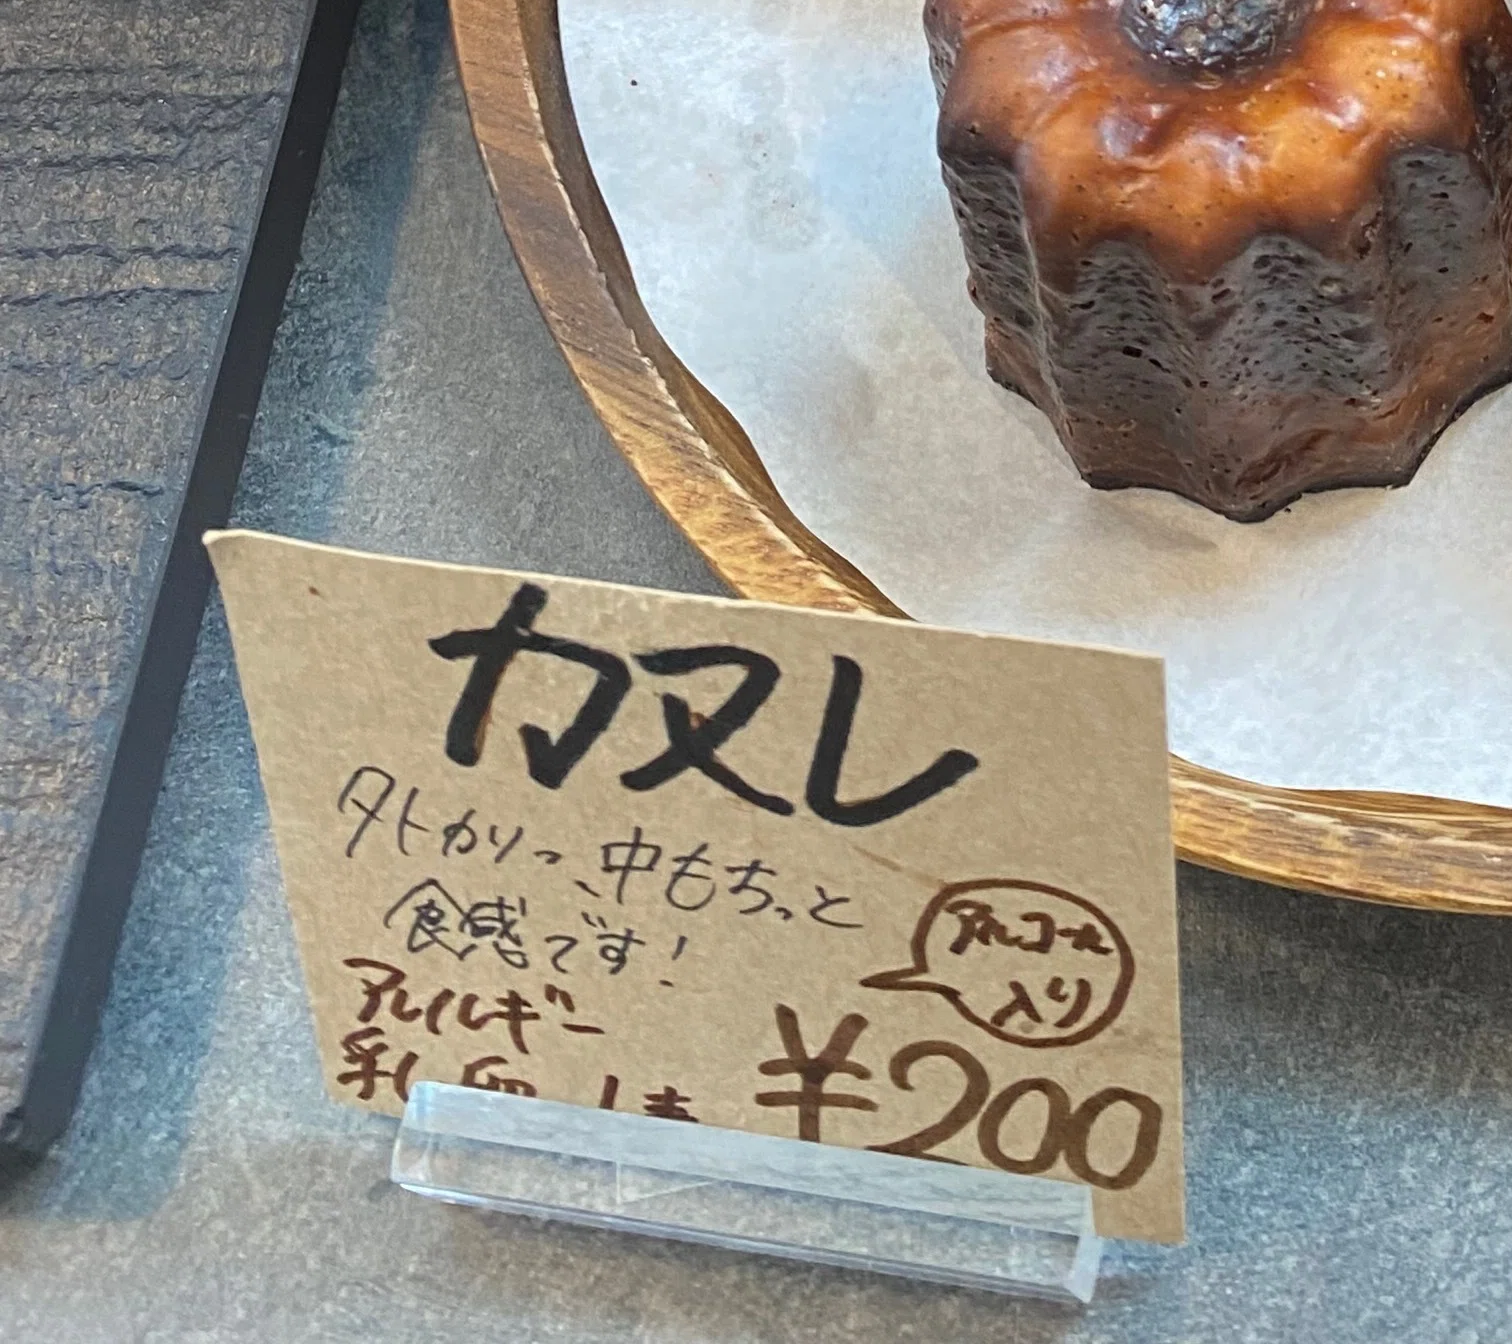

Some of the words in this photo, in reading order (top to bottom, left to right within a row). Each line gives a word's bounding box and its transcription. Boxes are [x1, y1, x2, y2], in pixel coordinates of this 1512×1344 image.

[429, 583, 979, 829] カヌレ
[754, 1002, 1164, 1191] ¥200
[990, 975, 1092, 1029] 入り
